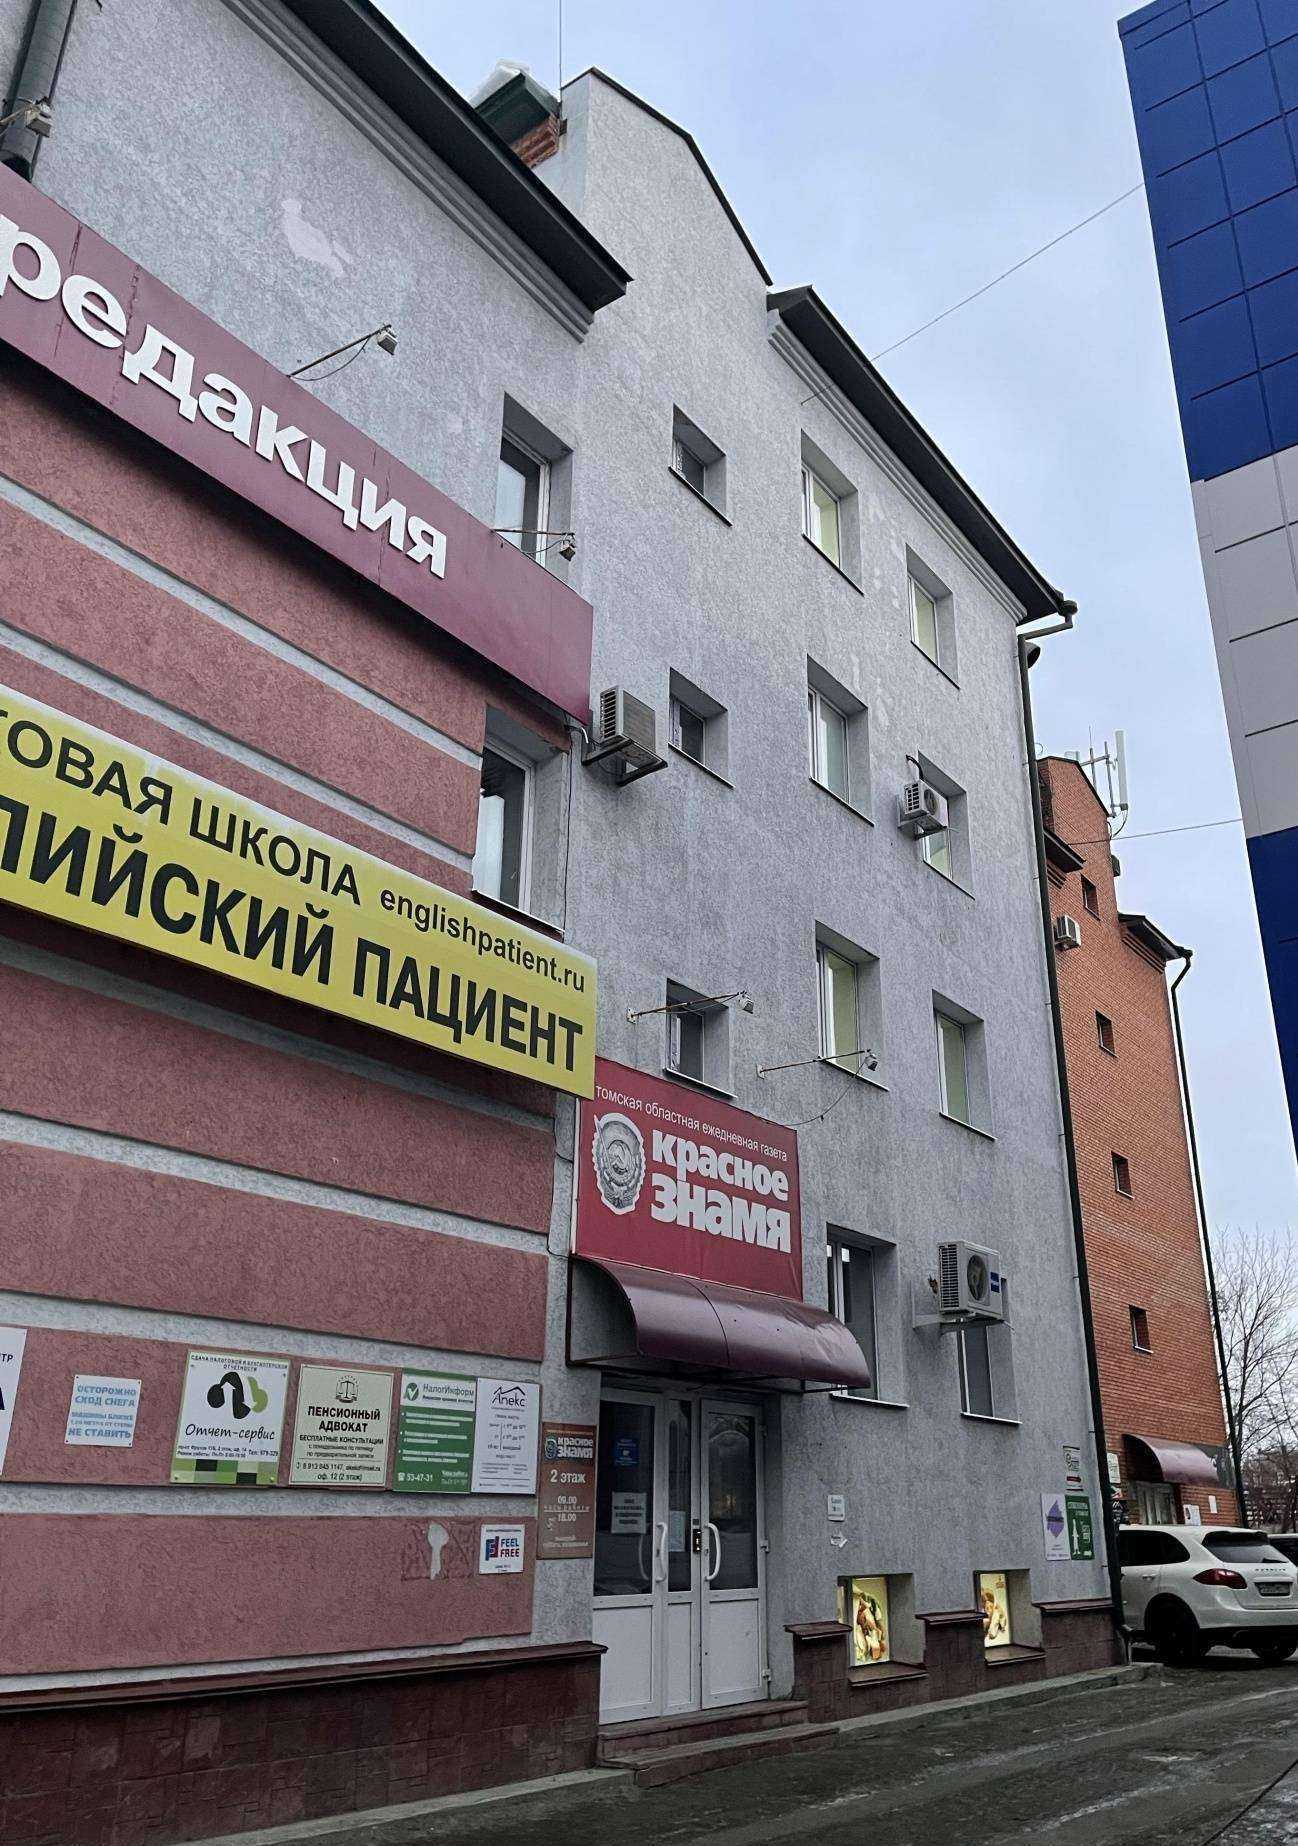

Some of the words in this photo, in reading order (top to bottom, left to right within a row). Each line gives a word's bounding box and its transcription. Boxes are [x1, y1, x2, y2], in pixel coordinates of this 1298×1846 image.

[0, 213, 447, 579] редакция
[0, 709, 173, 826] ОВАЯ
[189, 797, 362, 906] ШКОЛА
[380, 888, 585, 993] englishpatient.ru
[353, 937, 583, 1073] ПАЦИЕНТ
[645, 1102, 700, 1132] областная
[702, 1124, 759, 1151] ежедневная
[760, 1142, 788, 1162] газета
[652, 1129, 789, 1202] красное
[650, 1172, 792, 1254] знамя
[0, 1353, 14, 1362] ТР
[77, 1385, 137, 1396] ОСТОРОЖНО
[423, 1384, 474, 1396] НалогИнформ
[75, 1396, 102, 1406] СХОД
[104, 1398, 136, 1407] СНЕГА
[308, 1406, 381, 1420] ПЕНСИОННЫЙ
[68, 1428, 82, 1437] НЕ
[84, 1428, 131, 1439] СТАВИТЬ
[185, 1423, 275, 1443] Отчет-сервис
[319, 1421, 368, 1433] АДВОКАТ
[551, 1469, 558, 1483] 2
[560, 1473, 586, 1483] этаж
[501, 1537, 520, 1547] FEEL
[500, 1548, 520, 1558] FREE
